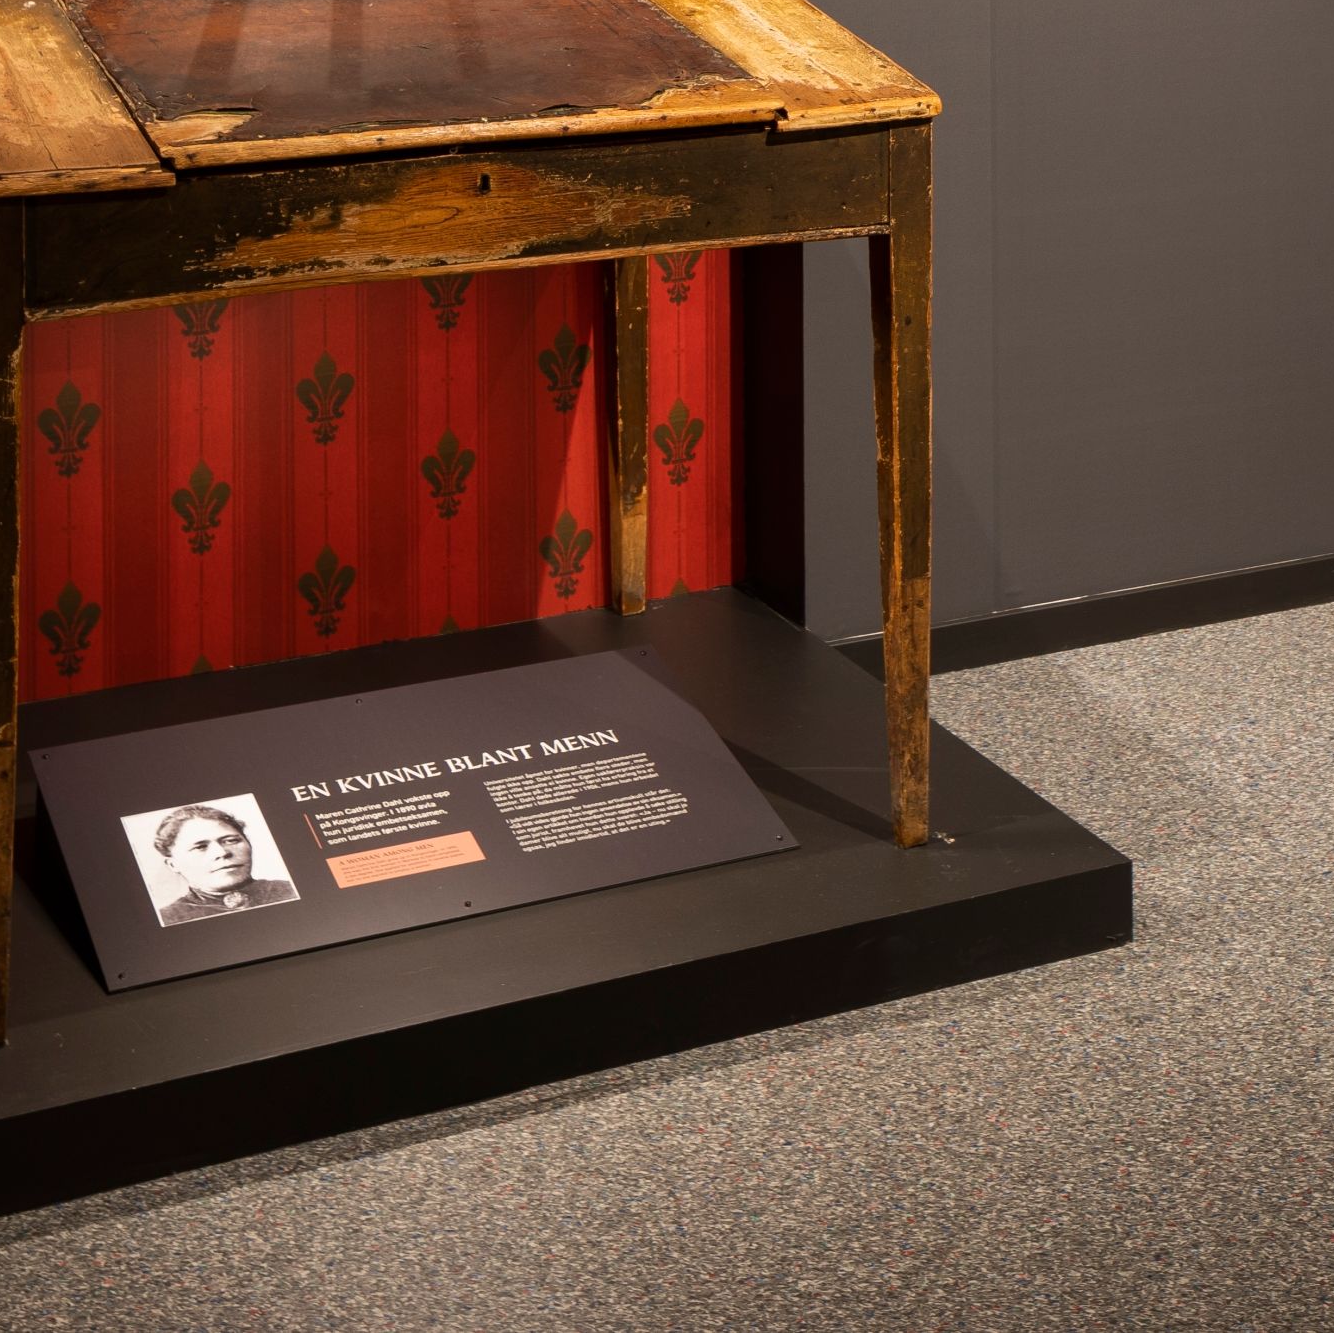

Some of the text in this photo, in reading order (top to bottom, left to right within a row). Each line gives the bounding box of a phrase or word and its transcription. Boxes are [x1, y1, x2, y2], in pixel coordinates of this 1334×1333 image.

[290, 729, 619, 802] EN KVINNE BLANT MENN
